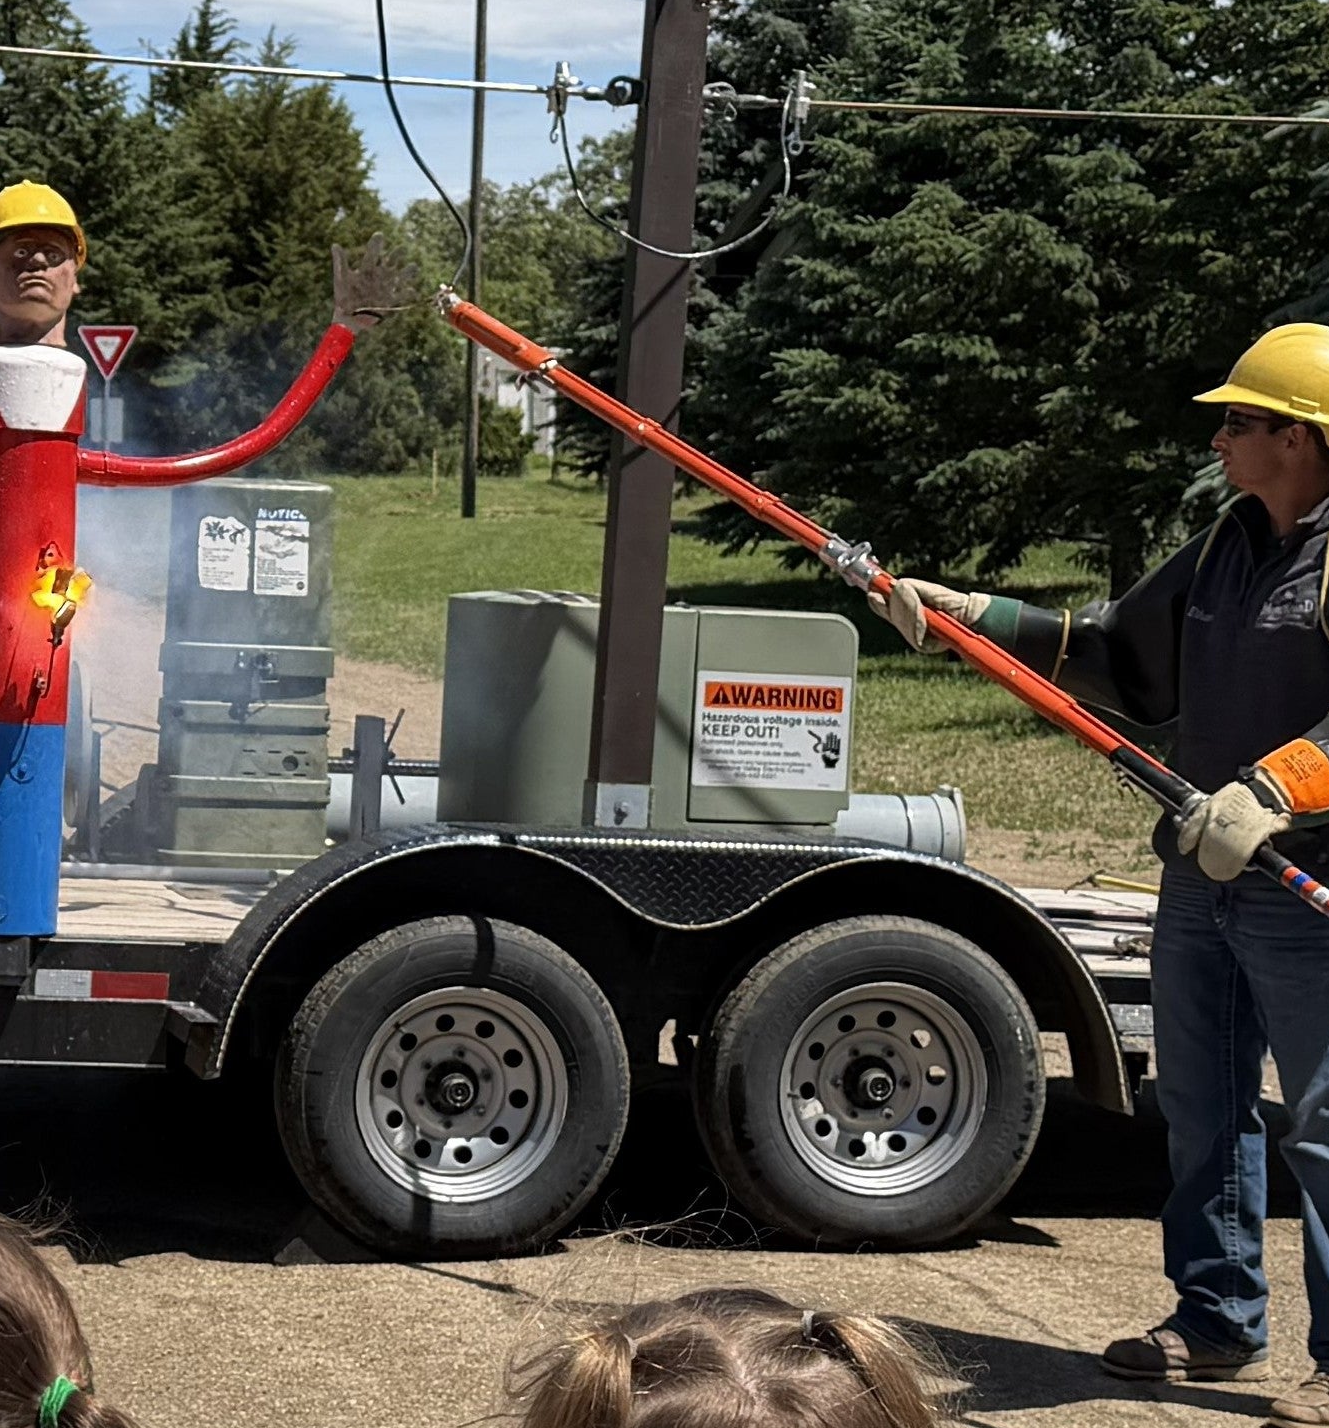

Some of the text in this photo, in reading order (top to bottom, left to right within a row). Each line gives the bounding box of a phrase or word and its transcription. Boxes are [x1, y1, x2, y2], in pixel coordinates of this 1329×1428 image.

[731, 685, 837, 710] WARNING
[702, 712, 841, 728] Hazardous voltage inside.
[701, 724, 780, 739] KEEP OUT!
